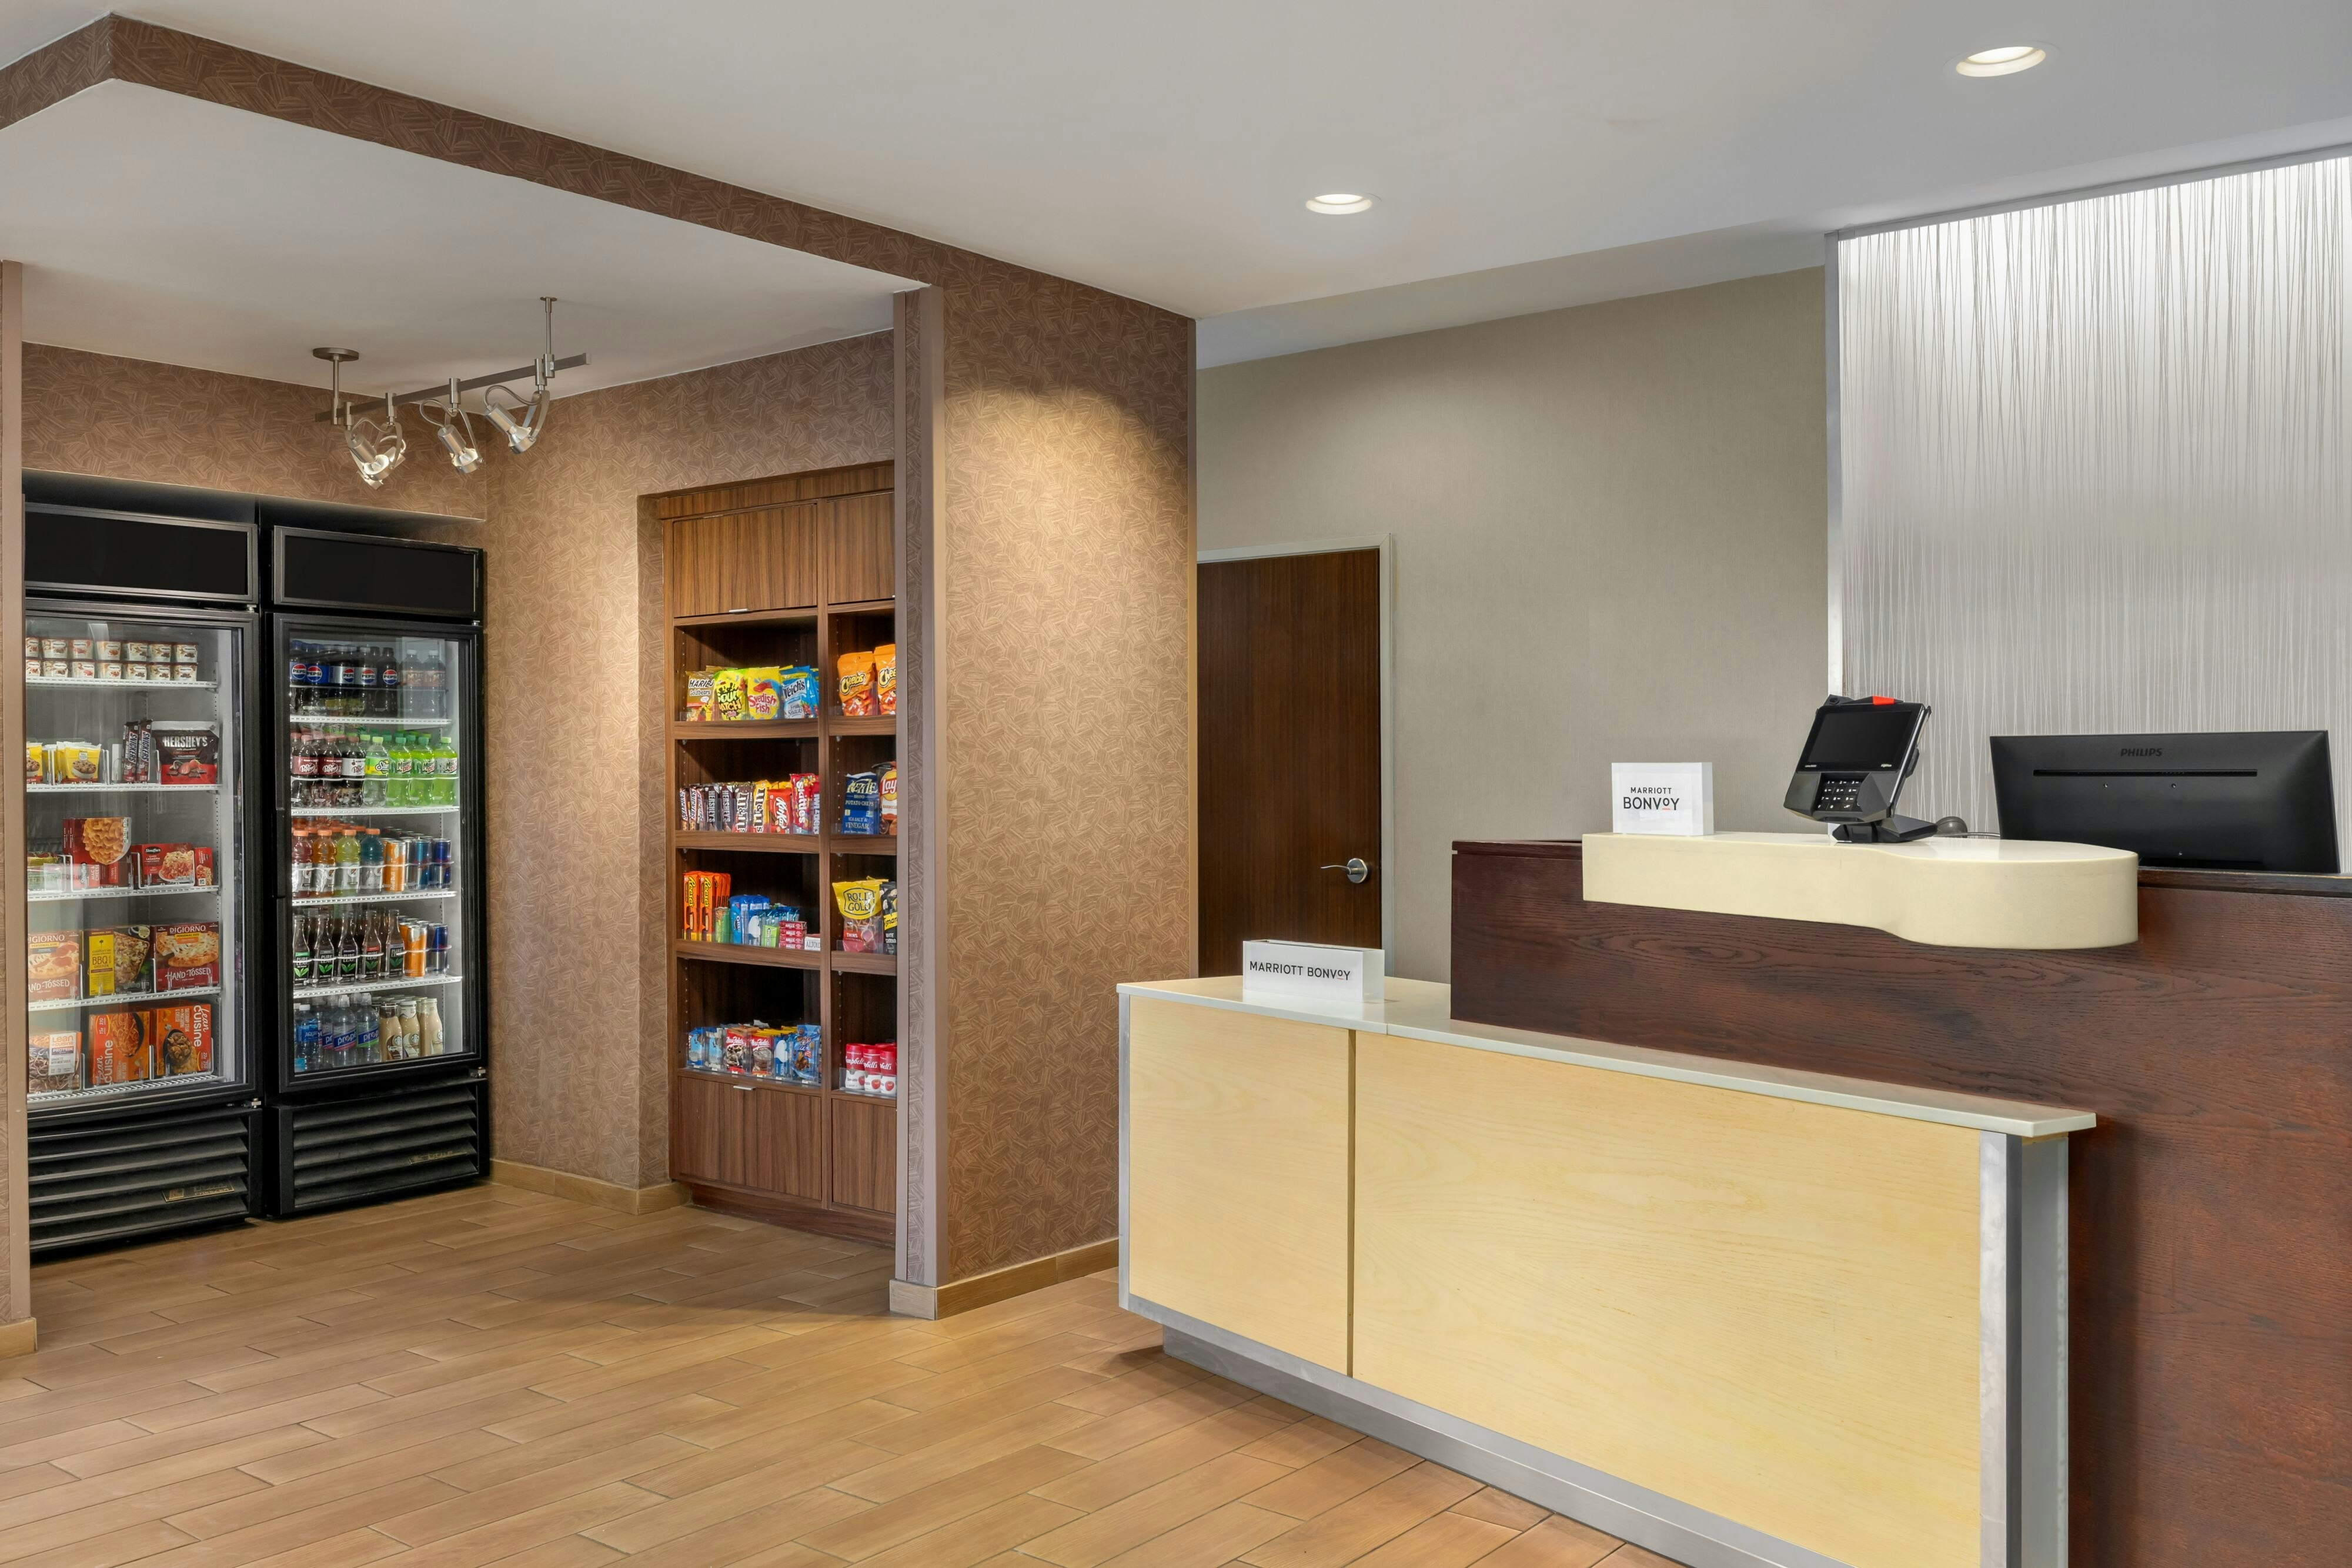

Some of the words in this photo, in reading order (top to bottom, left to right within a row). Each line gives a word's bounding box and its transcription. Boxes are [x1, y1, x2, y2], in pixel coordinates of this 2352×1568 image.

[878, 668, 896, 687] Chee
[748, 694, 776, 707] Swedish
[756, 704, 770, 714] Fish
[142, 732, 151, 762] SNICKERS
[162, 735, 208, 747] HERSHEY'S
[128, 733, 138, 763] SNICKERS
[2120, 747, 2163, 757] PHILIPS
[846, 778, 878, 794] KETTLE
[882, 779, 897, 794] Lay
[722, 790, 731, 822] HERSHEY'S
[1623, 797, 1680, 811] BONVOY
[847, 902, 871, 911] GOLD
[169, 925, 206, 934] DIGIORNO
[28, 934, 65, 944] IGIORNO
[92, 955, 108, 965] BBQ
[1250, 960, 1304, 975] MARRIOTT
[1307, 967, 1350, 981] BONVOY
[201, 1008, 210, 1032] Lean
[52, 1035, 74, 1043] Lean
